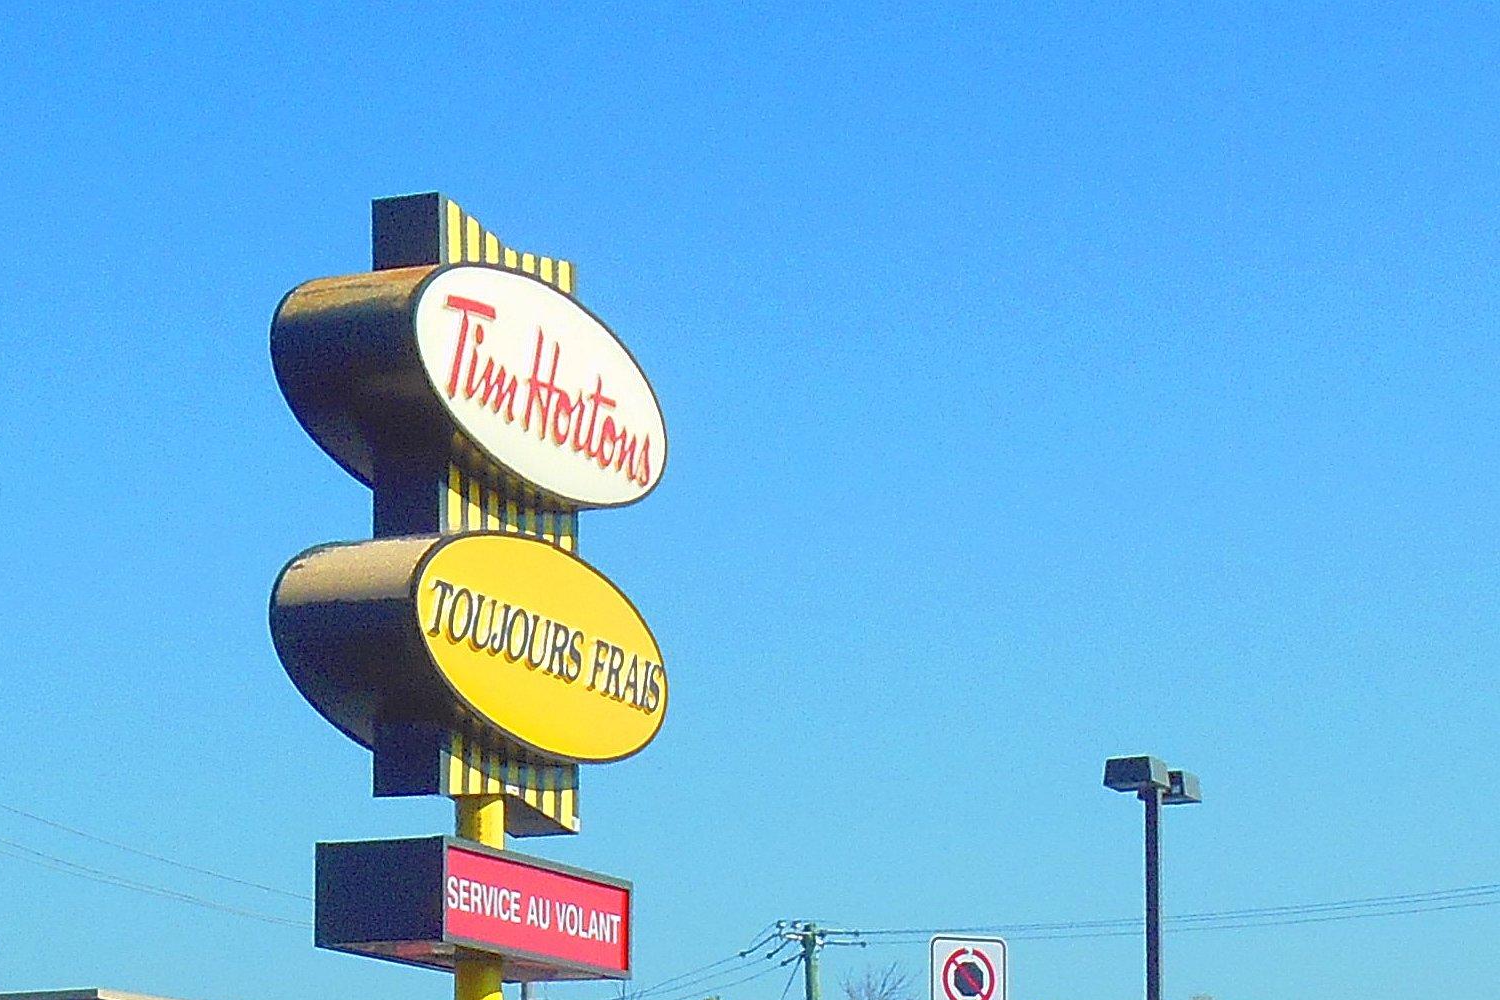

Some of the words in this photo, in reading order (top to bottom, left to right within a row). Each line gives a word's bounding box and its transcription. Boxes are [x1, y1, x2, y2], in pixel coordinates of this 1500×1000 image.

[445, 295, 518, 424] Tim
[523, 326, 650, 487] Hortons
[428, 580, 584, 682] TOUJOURS
[588, 640, 663, 714] FRAIS
[447, 876, 521, 923] SERVICE
[527, 896, 550, 930] AU
[555, 901, 621, 944] VOLANT
